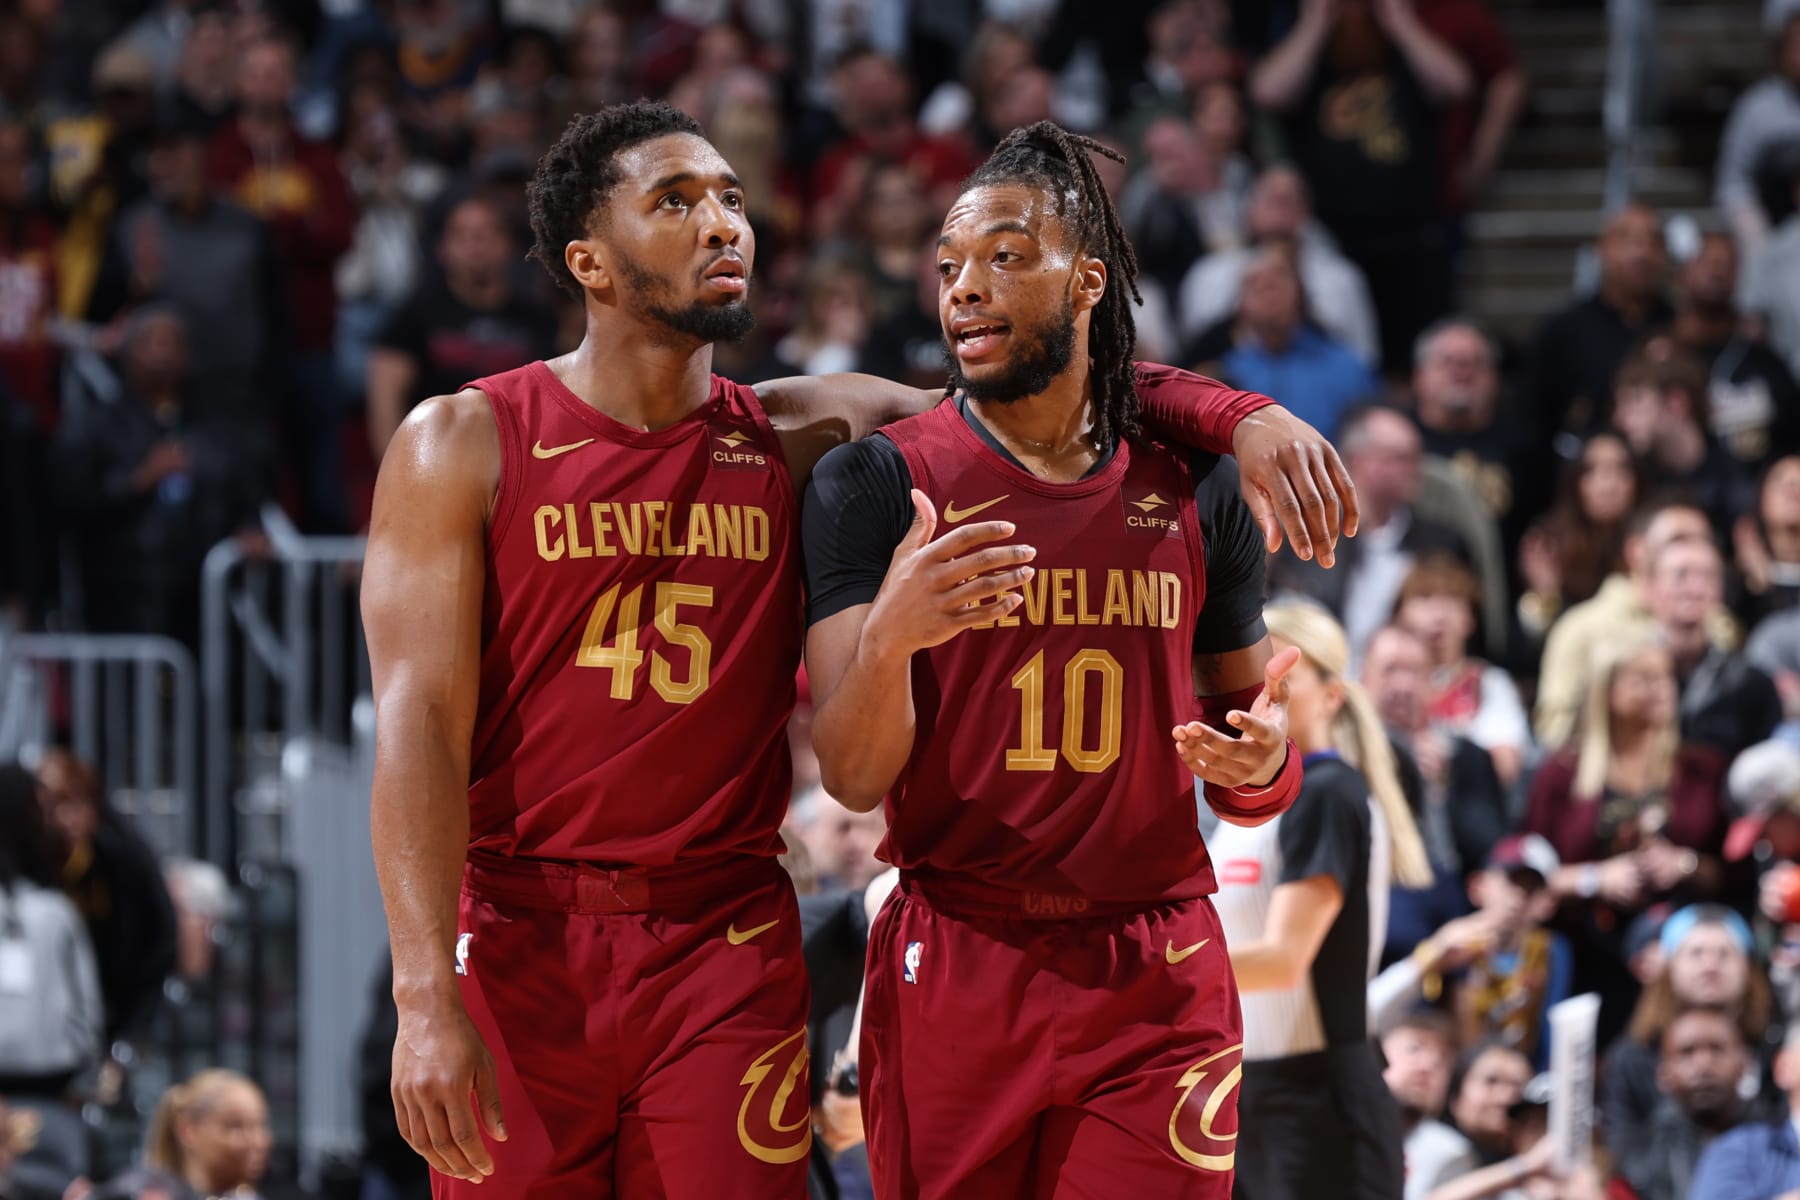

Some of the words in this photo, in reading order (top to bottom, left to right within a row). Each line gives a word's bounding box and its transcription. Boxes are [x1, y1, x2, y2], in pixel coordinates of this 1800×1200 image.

[713, 451, 766, 465] CLIFFS
[533, 502, 769, 562] CLEVELAND
[1127, 516, 1179, 531] CLIFFS
[967, 568, 1182, 629] VELAND
[575, 582, 713, 704] 45
[1006, 648, 1123, 773] 10
[1023, 892, 1089, 914] CAVS
